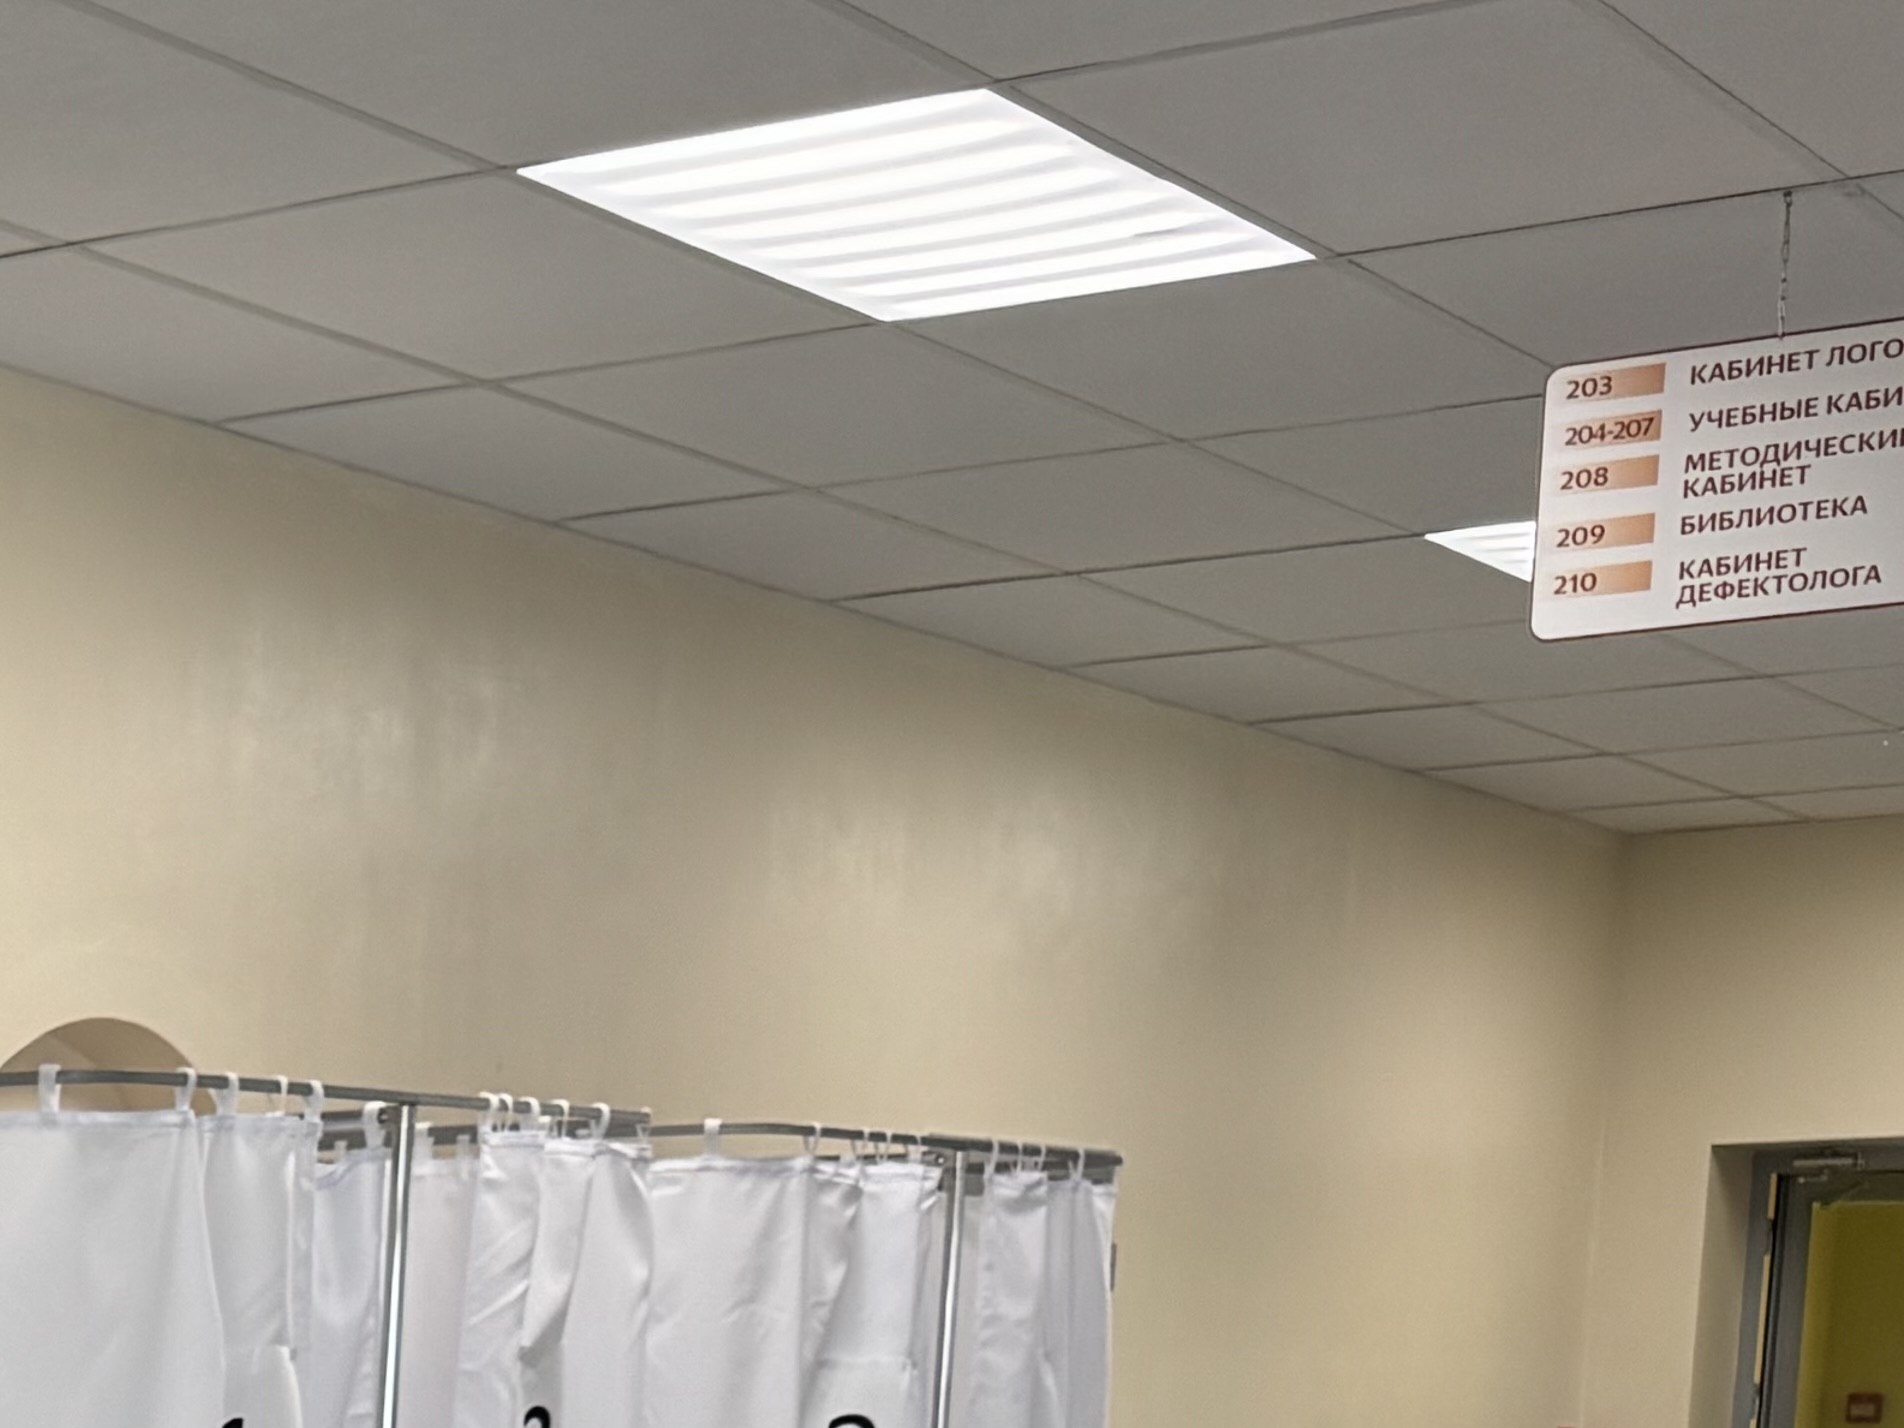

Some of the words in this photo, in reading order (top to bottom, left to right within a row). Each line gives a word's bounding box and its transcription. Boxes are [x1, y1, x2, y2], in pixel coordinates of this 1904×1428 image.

[1690, 349, 1820, 385] КАБИНЕТ
[1825, 338, 1904, 367] ЛОГО
[1566, 375, 1613, 400] 203
[1688, 397, 1819, 432] УЧЕБНЫЕ
[1826, 385, 1904, 415] КАБИ
[1564, 416, 1655, 447] 204-207
[1683, 427, 1904, 474] МЕТОДИЧЕСКИ
[1559, 466, 1608, 490] 208
[1682, 464, 1811, 499] КАБИНЕТ
[1679, 495, 1868, 536] БИБЛИОТЕКА
[1556, 524, 1606, 548] 209
[1678, 547, 1808, 581] КАБИНЕТ
[1552, 572, 1598, 596] 210
[1675, 564, 1883, 609] ДЕФЕКТОЛОГА
